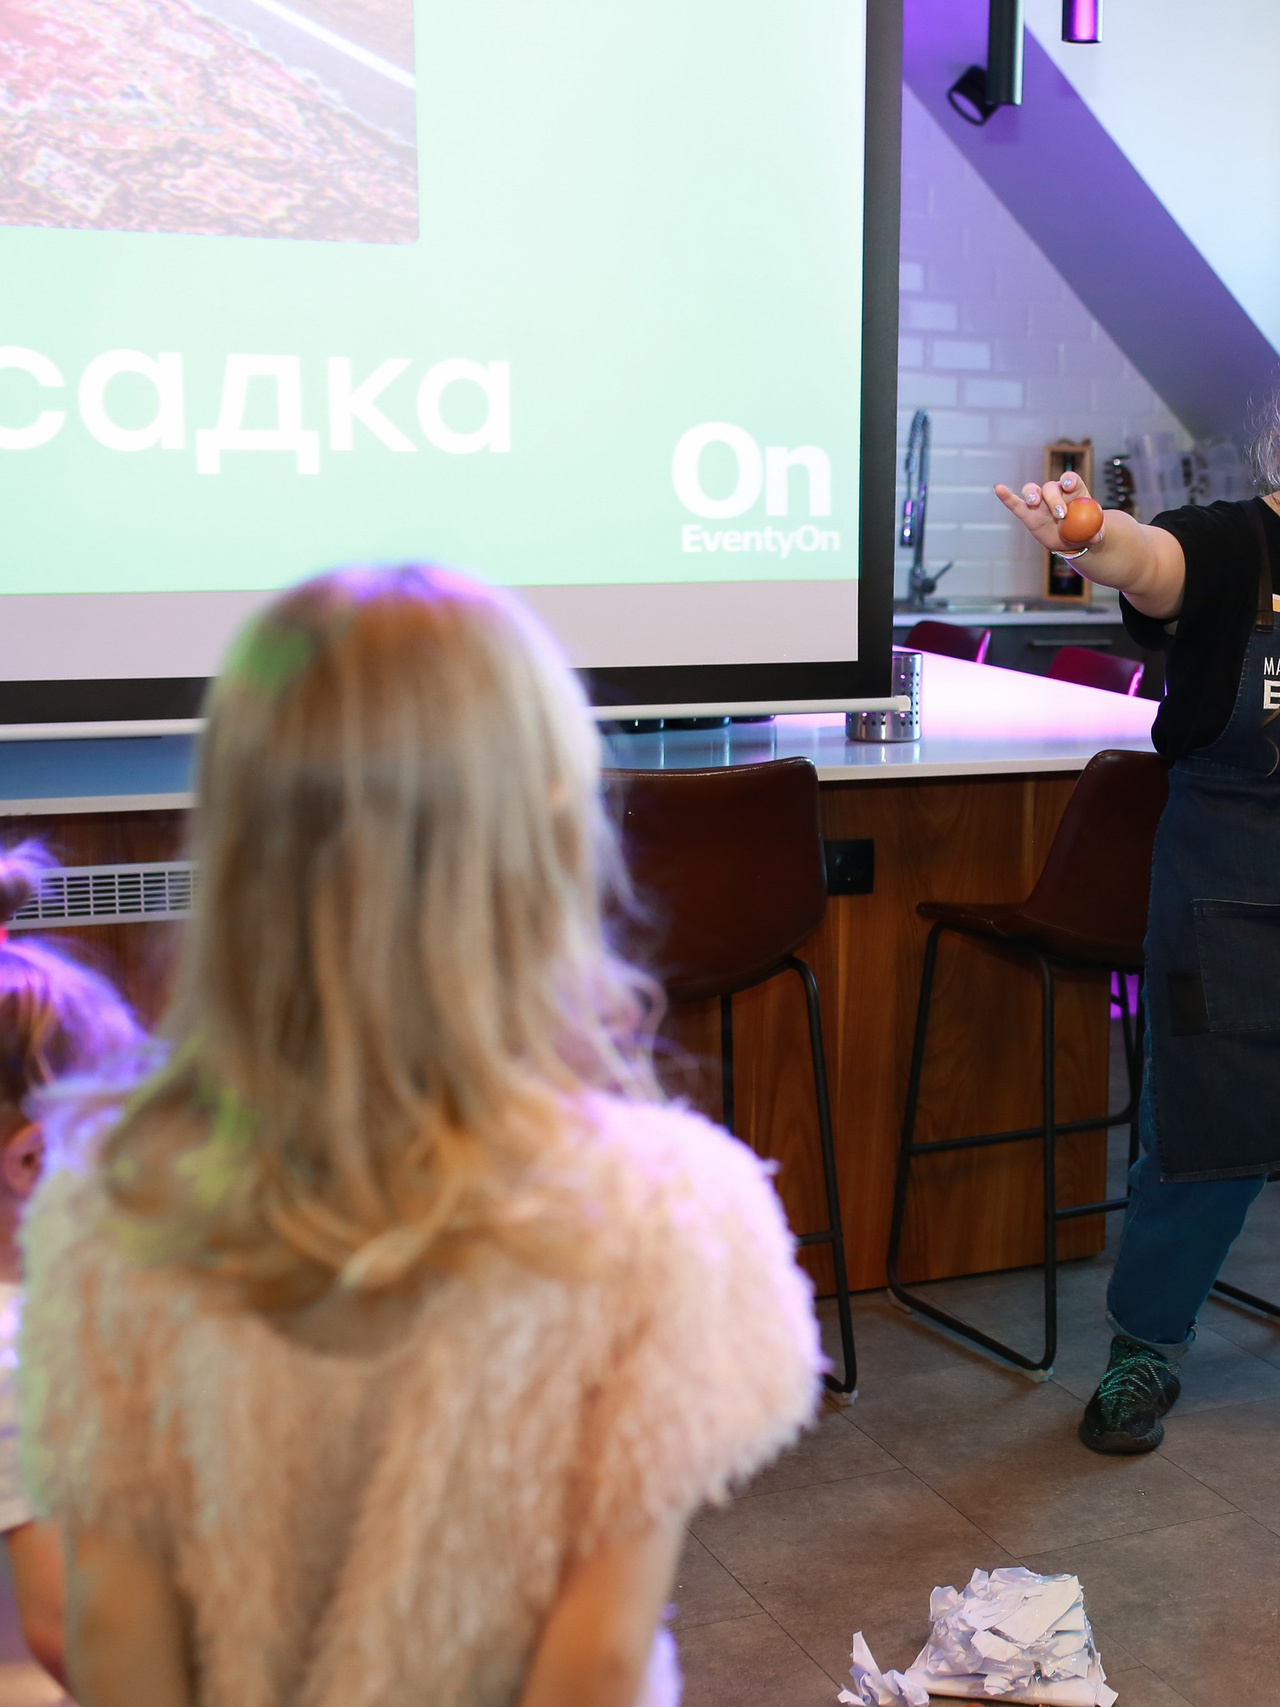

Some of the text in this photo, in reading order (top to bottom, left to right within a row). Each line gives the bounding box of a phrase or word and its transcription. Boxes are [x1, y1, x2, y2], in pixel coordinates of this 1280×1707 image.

[0, 346, 511, 475] садка
[672, 421, 832, 519] On
[681, 524, 841, 559] EventyOn
